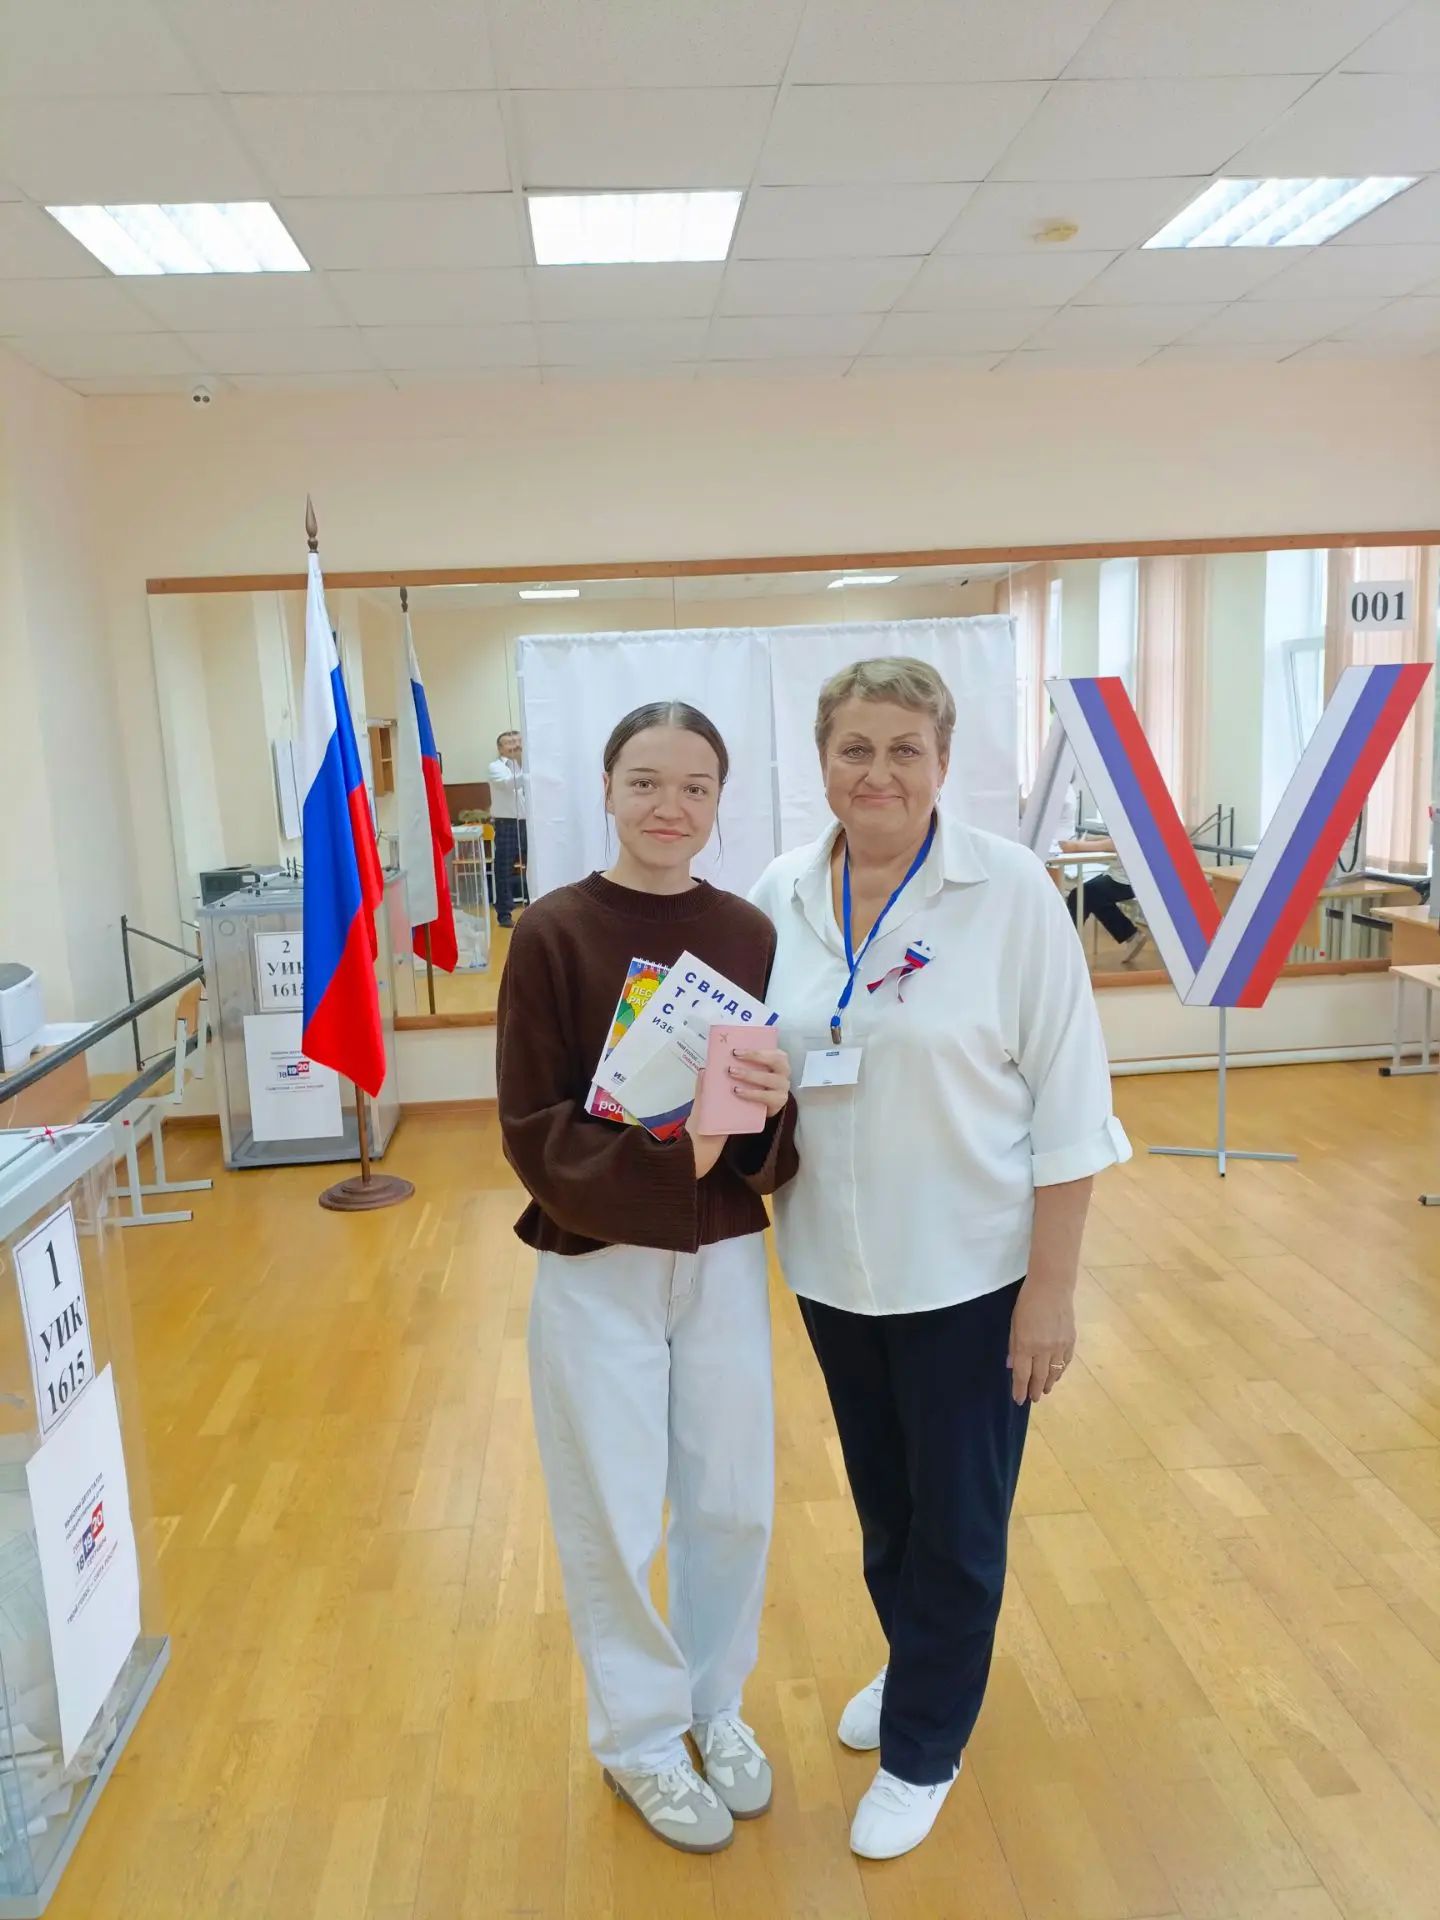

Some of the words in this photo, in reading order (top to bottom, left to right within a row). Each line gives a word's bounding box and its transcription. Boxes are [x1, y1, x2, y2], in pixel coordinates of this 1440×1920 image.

[1351, 591, 1407, 622] 001
[281, 940, 290, 953] 2
[45, 1240, 63, 1291] 1
[40, 1295, 83, 1363] УИК
[48, 1349, 85, 1415] 1615
[76, 1554, 85, 1575] 18
